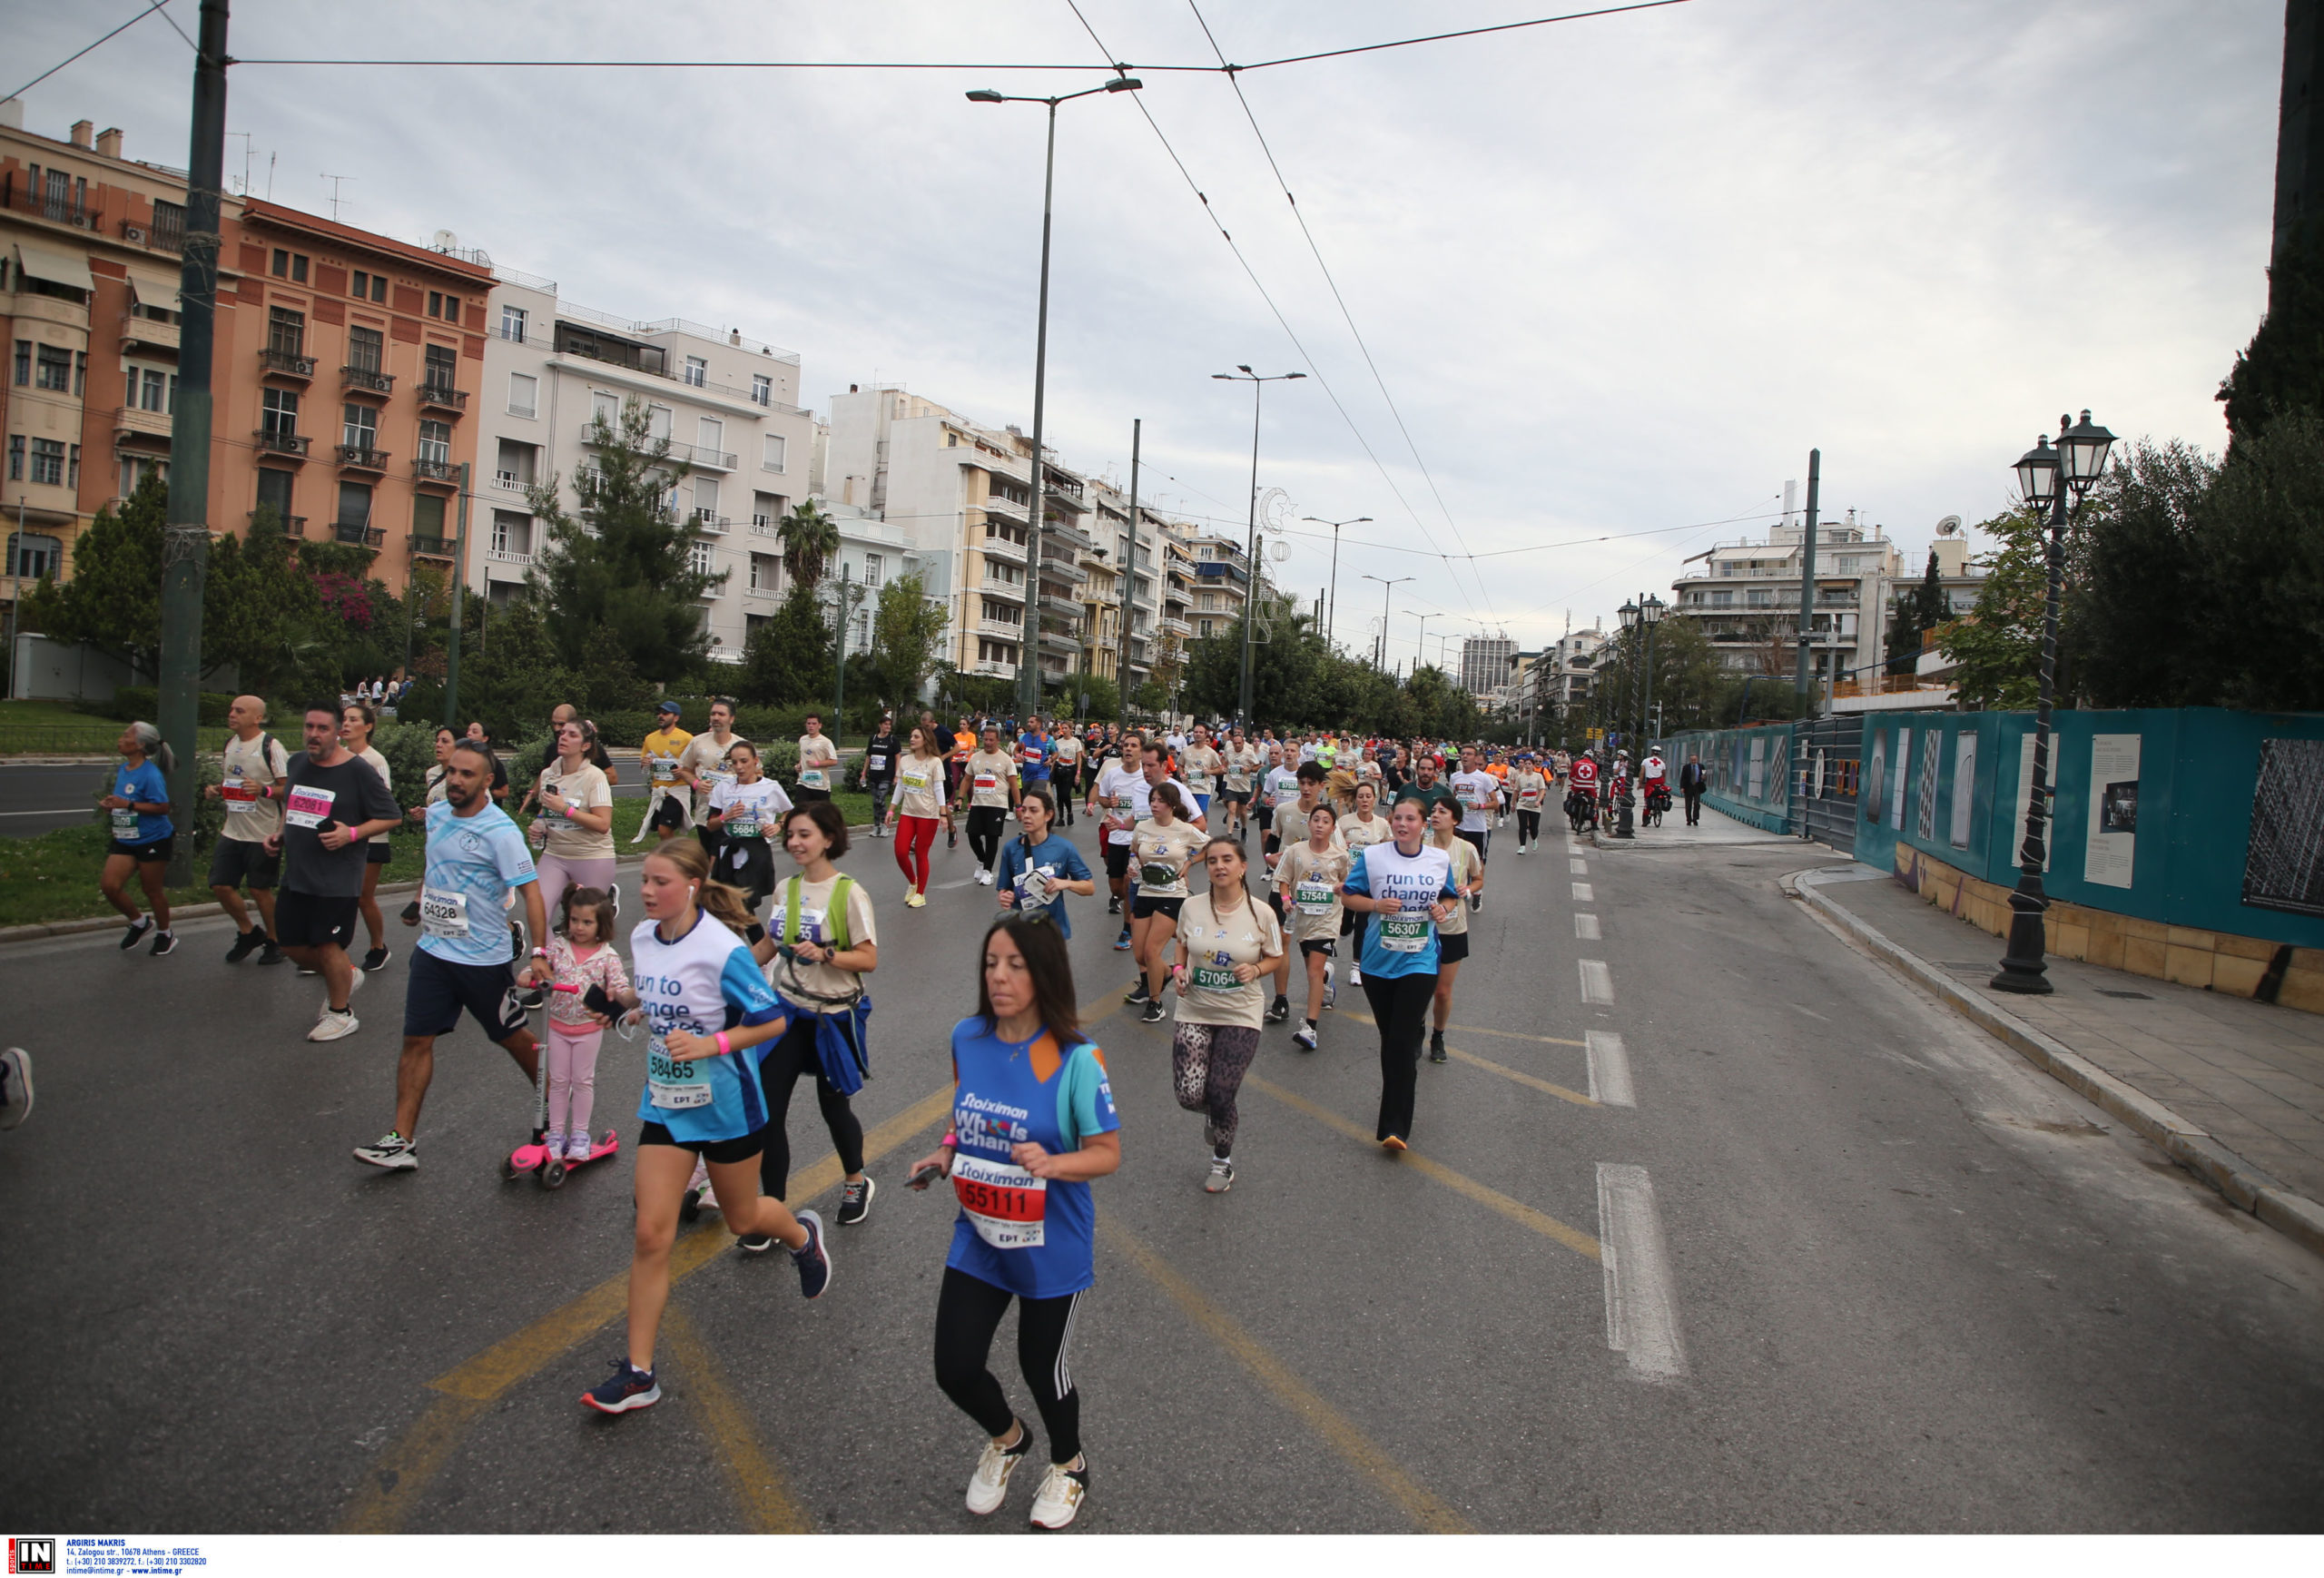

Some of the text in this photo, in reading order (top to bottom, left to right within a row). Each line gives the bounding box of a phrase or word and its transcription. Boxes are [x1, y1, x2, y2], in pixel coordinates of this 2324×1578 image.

[1386, 873, 1434, 886] run to
[1301, 892, 1327, 902] 57544
[1381, 885, 1437, 904] change
[424, 902, 457, 919] 64328
[1387, 922, 1422, 935] 56307
[660, 975, 683, 996] to
[1199, 970, 1236, 985] 57064
[650, 1056, 694, 1079] 58465
[960, 1092, 1029, 1120] Stoiximan
[958, 1160, 1035, 1187] Stoiximan
[965, 1183, 1026, 1214] 55111
